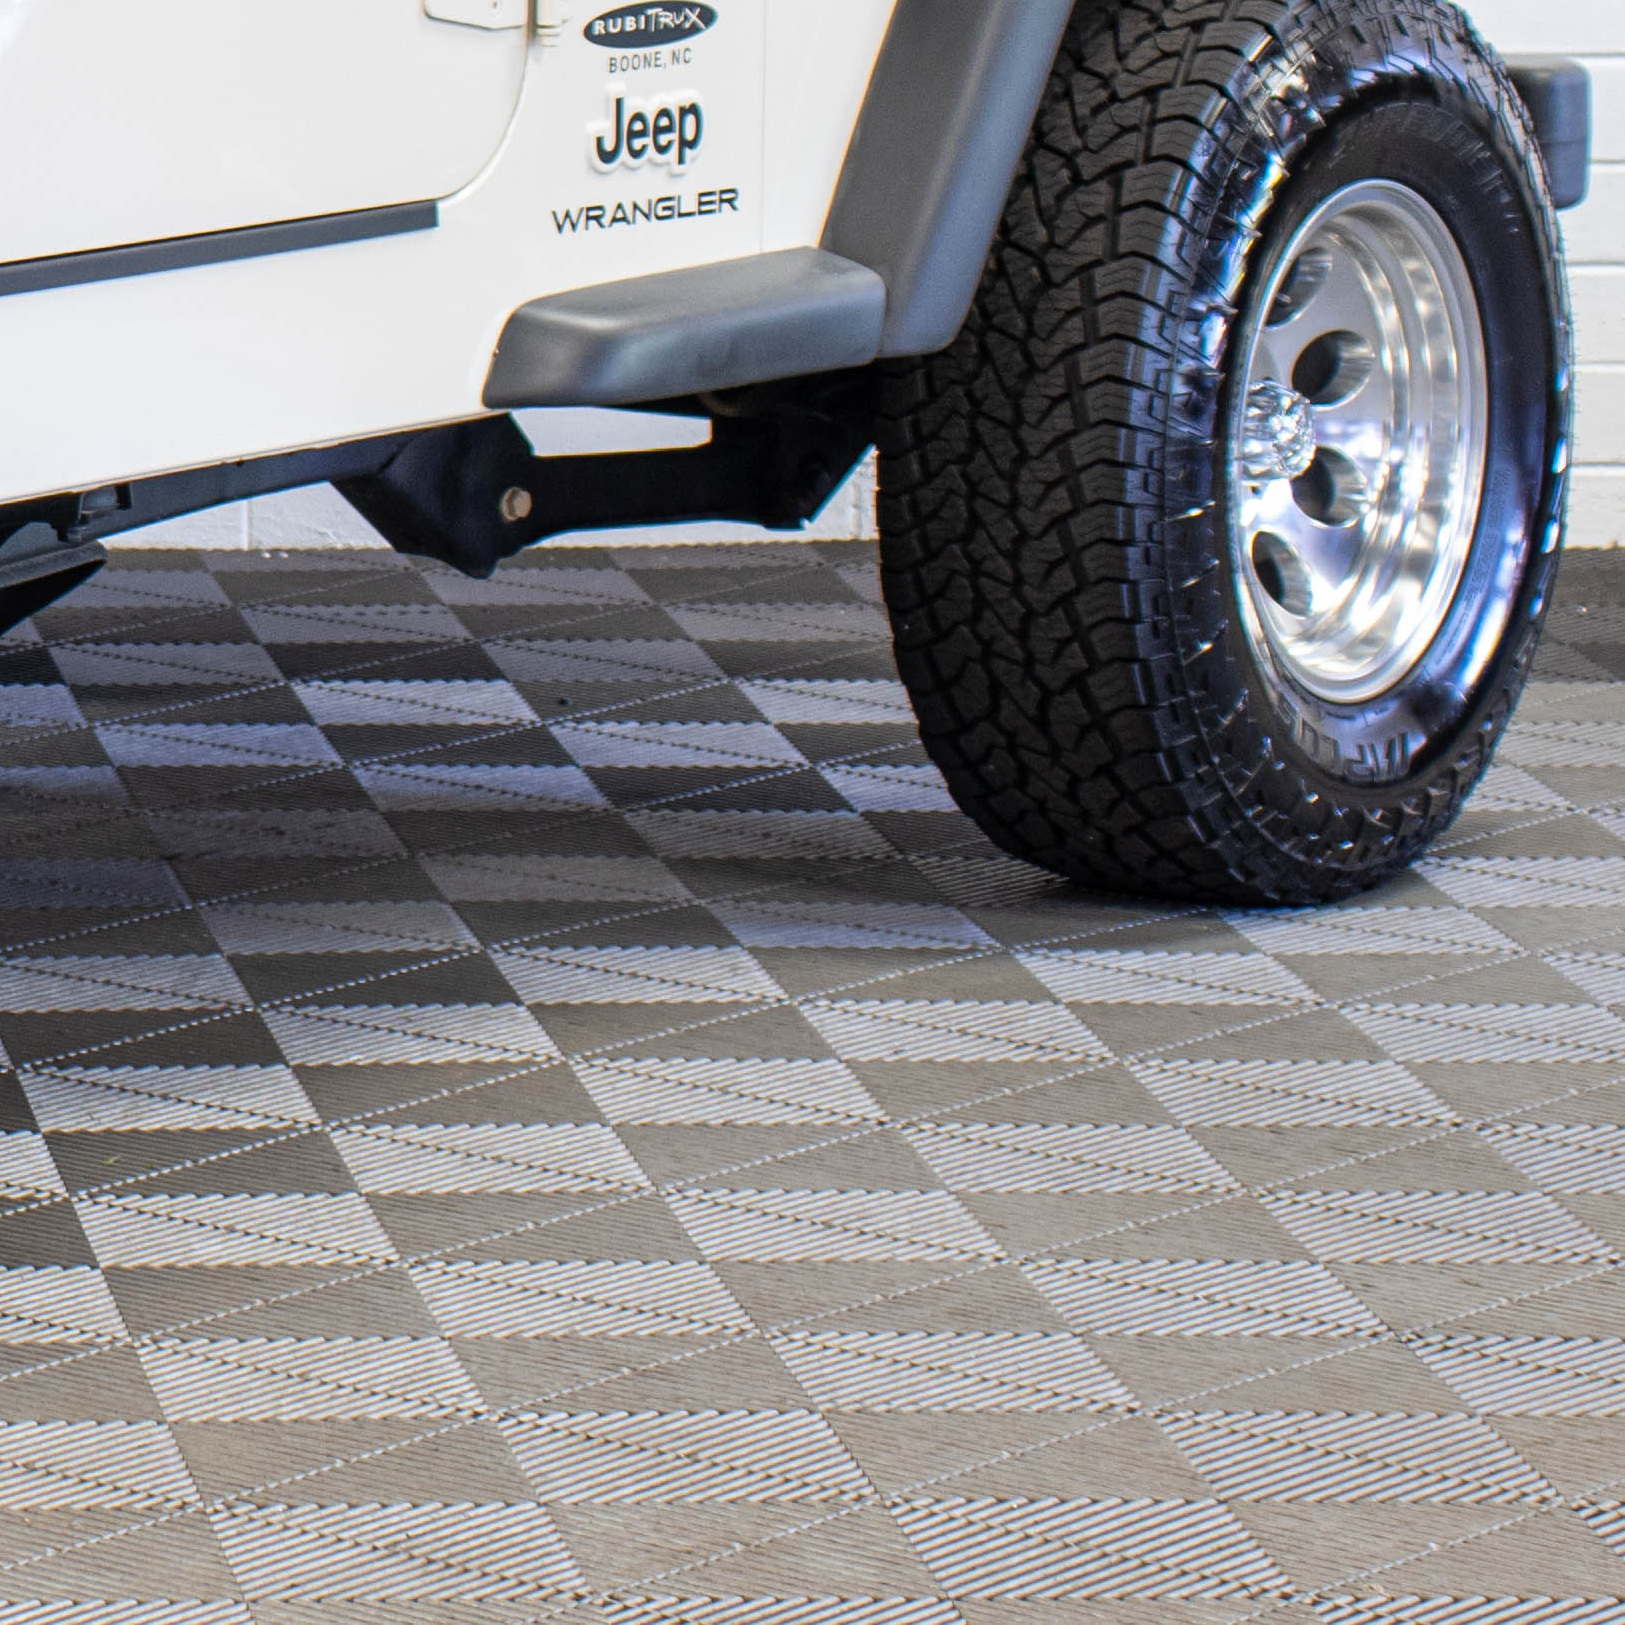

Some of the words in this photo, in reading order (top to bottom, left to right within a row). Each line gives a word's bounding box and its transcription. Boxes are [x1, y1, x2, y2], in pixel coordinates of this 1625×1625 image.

[607, 50, 667, 74] BOONE,
[671, 46, 693, 66] NC
[595, 95, 705, 166] Jeep
[551, 187, 740, 235] WRANGLER
